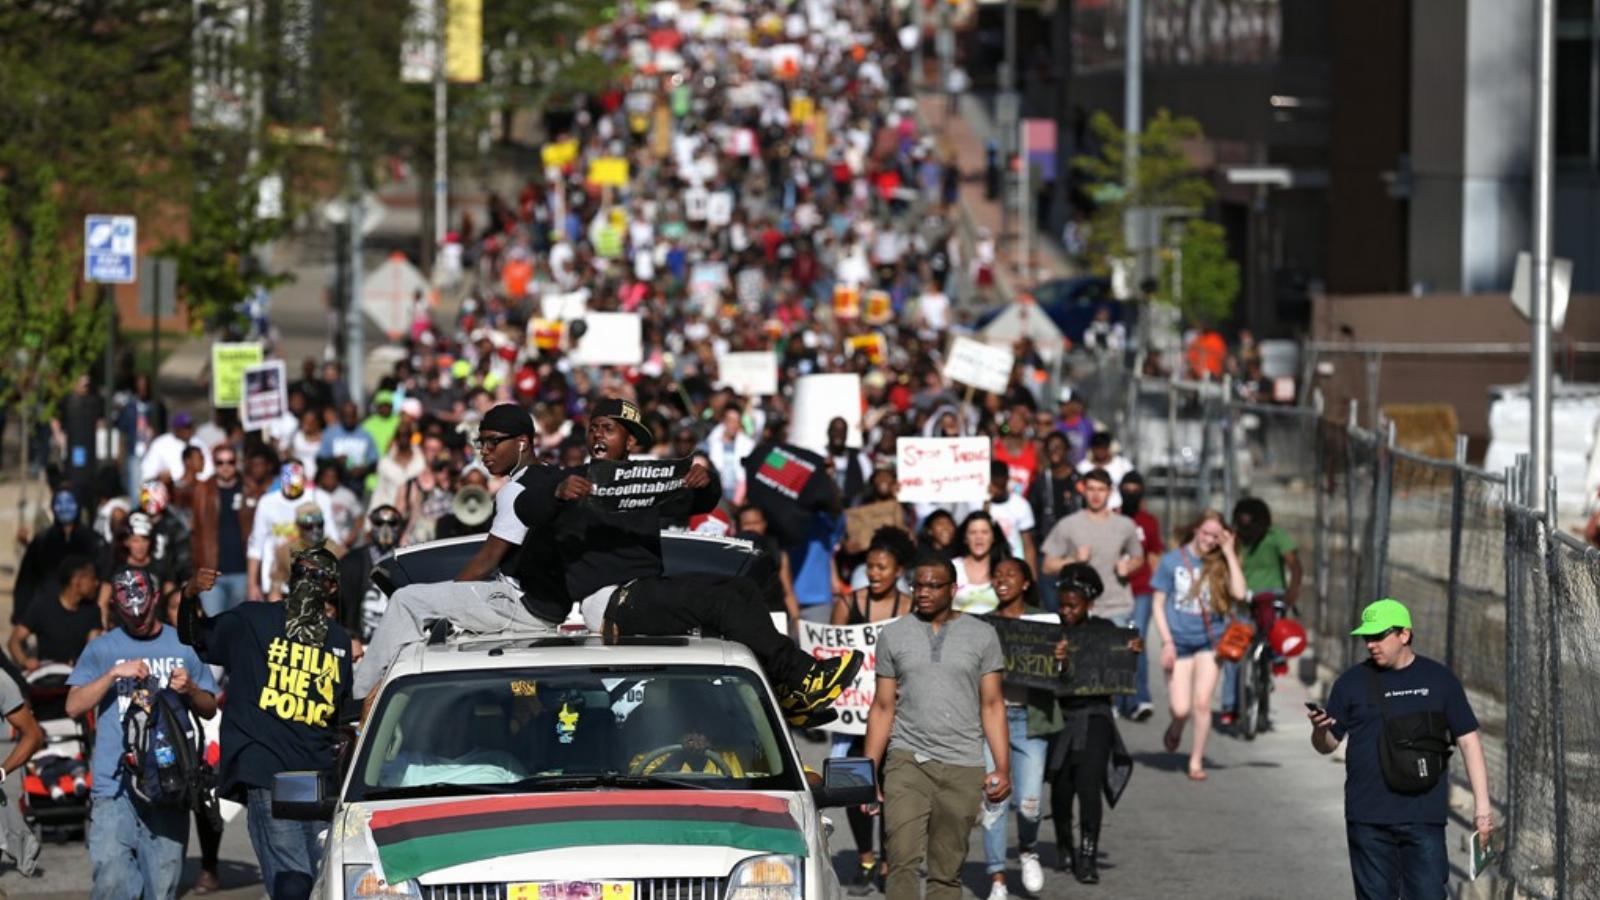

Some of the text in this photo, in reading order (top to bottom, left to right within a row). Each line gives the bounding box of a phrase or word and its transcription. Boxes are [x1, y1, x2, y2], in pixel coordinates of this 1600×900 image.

[614, 465, 676, 481] Political
[618, 496, 656, 509] Now!
[115, 657, 185, 676] ANGE
[267, 637, 341, 684] #FILM
[267, 661, 311, 699] THE
[258, 686, 335, 728] POLIC
